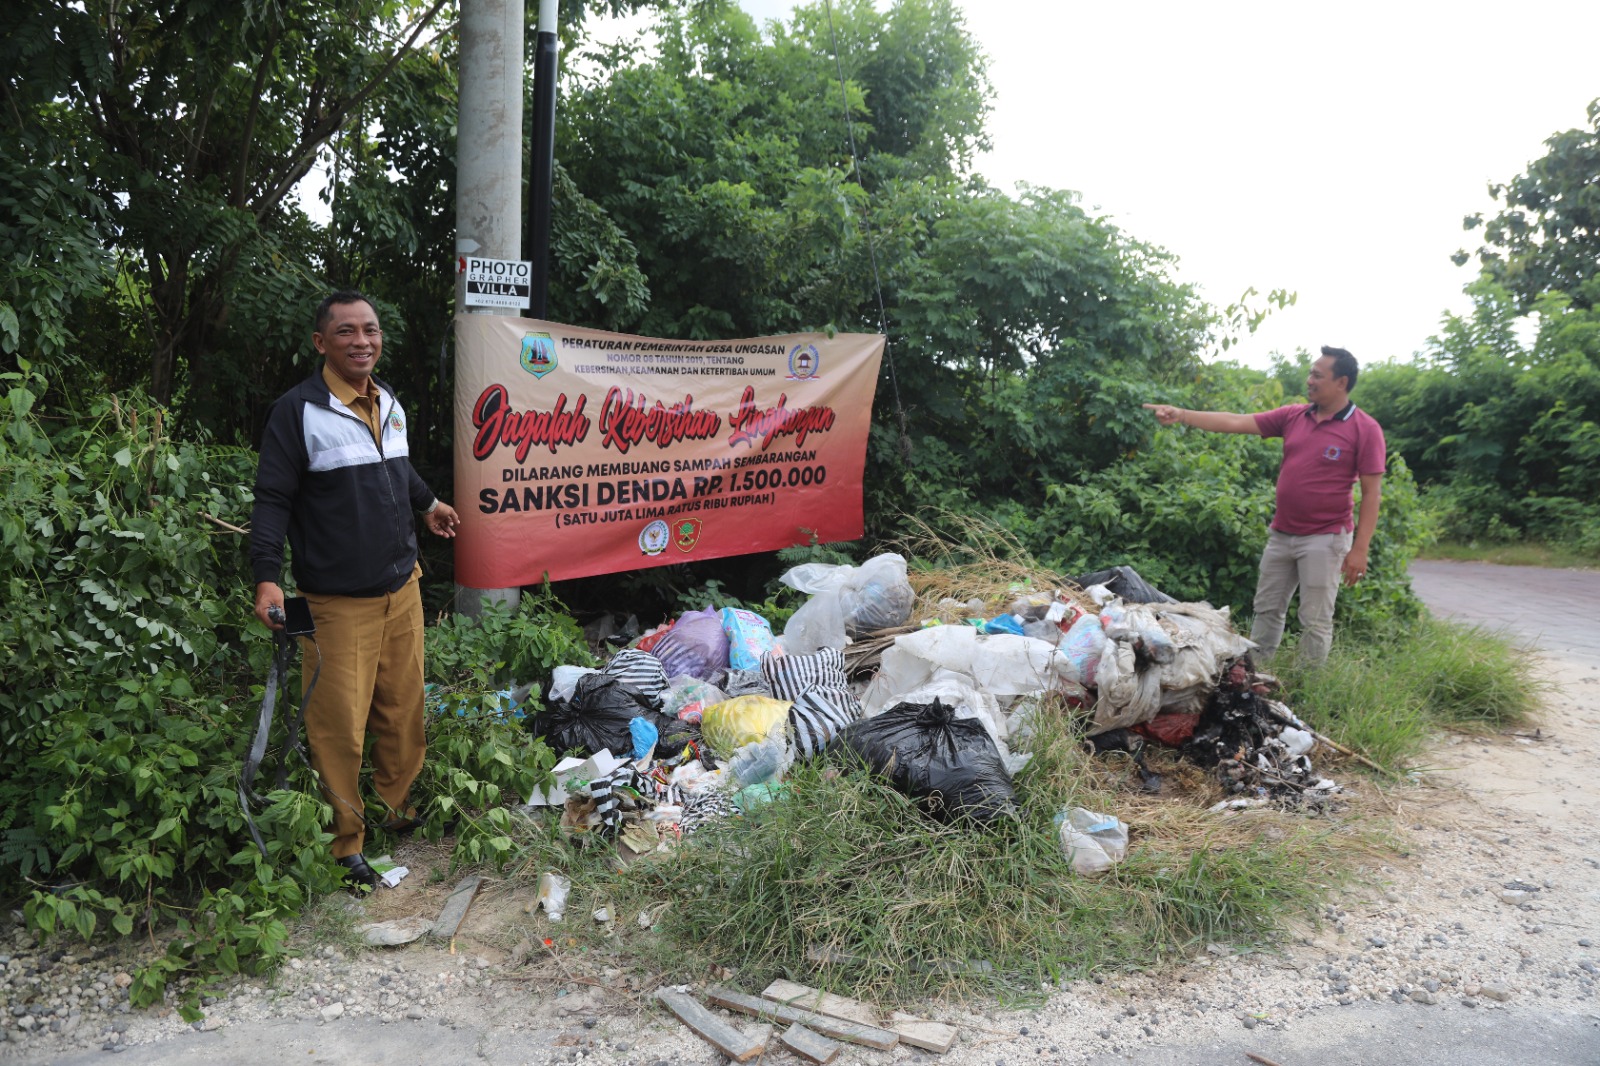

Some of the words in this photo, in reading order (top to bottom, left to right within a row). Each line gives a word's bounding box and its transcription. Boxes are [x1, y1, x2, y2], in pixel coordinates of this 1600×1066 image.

[471, 260, 528, 276] PHOTO
[470, 274, 528, 284] GRAPHER
[477, 282, 517, 296] VILLA
[562, 338, 632, 350] PERATURAN
[634, 342, 705, 352] PEMERINTAH
[706, 345, 732, 353] DESA
[734, 345, 785, 354] UNGASAN
[607, 354, 641, 362] NOMOR
[644, 354, 654, 363] 08
[655, 355, 684, 364] TAHUN
[707, 356, 744, 365] TENTANG
[701, 368, 748, 376] KETERTIBAN
[472, 384, 590, 464] Jagalah
[599, 385, 721, 454] Kebersihan
[728, 385, 836, 451] Lingkungan
[502, 465, 583, 482] DILARANG
[587, 461, 670, 477] MEMBUANG
[674, 458, 731, 472] SAMPAH
[734, 450, 816, 468] SEMBARANGAN
[478, 483, 589, 514] SANKSI
[597, 477, 687, 506] DENDA
[692, 475, 723, 498] RP.
[730, 465, 826, 491] 1.500.000
[601, 510, 633, 523] JUTA
[636, 507, 665, 519] LIMA
[667, 501, 701, 516] RATUS
[703, 498, 728, 510] RIBU
